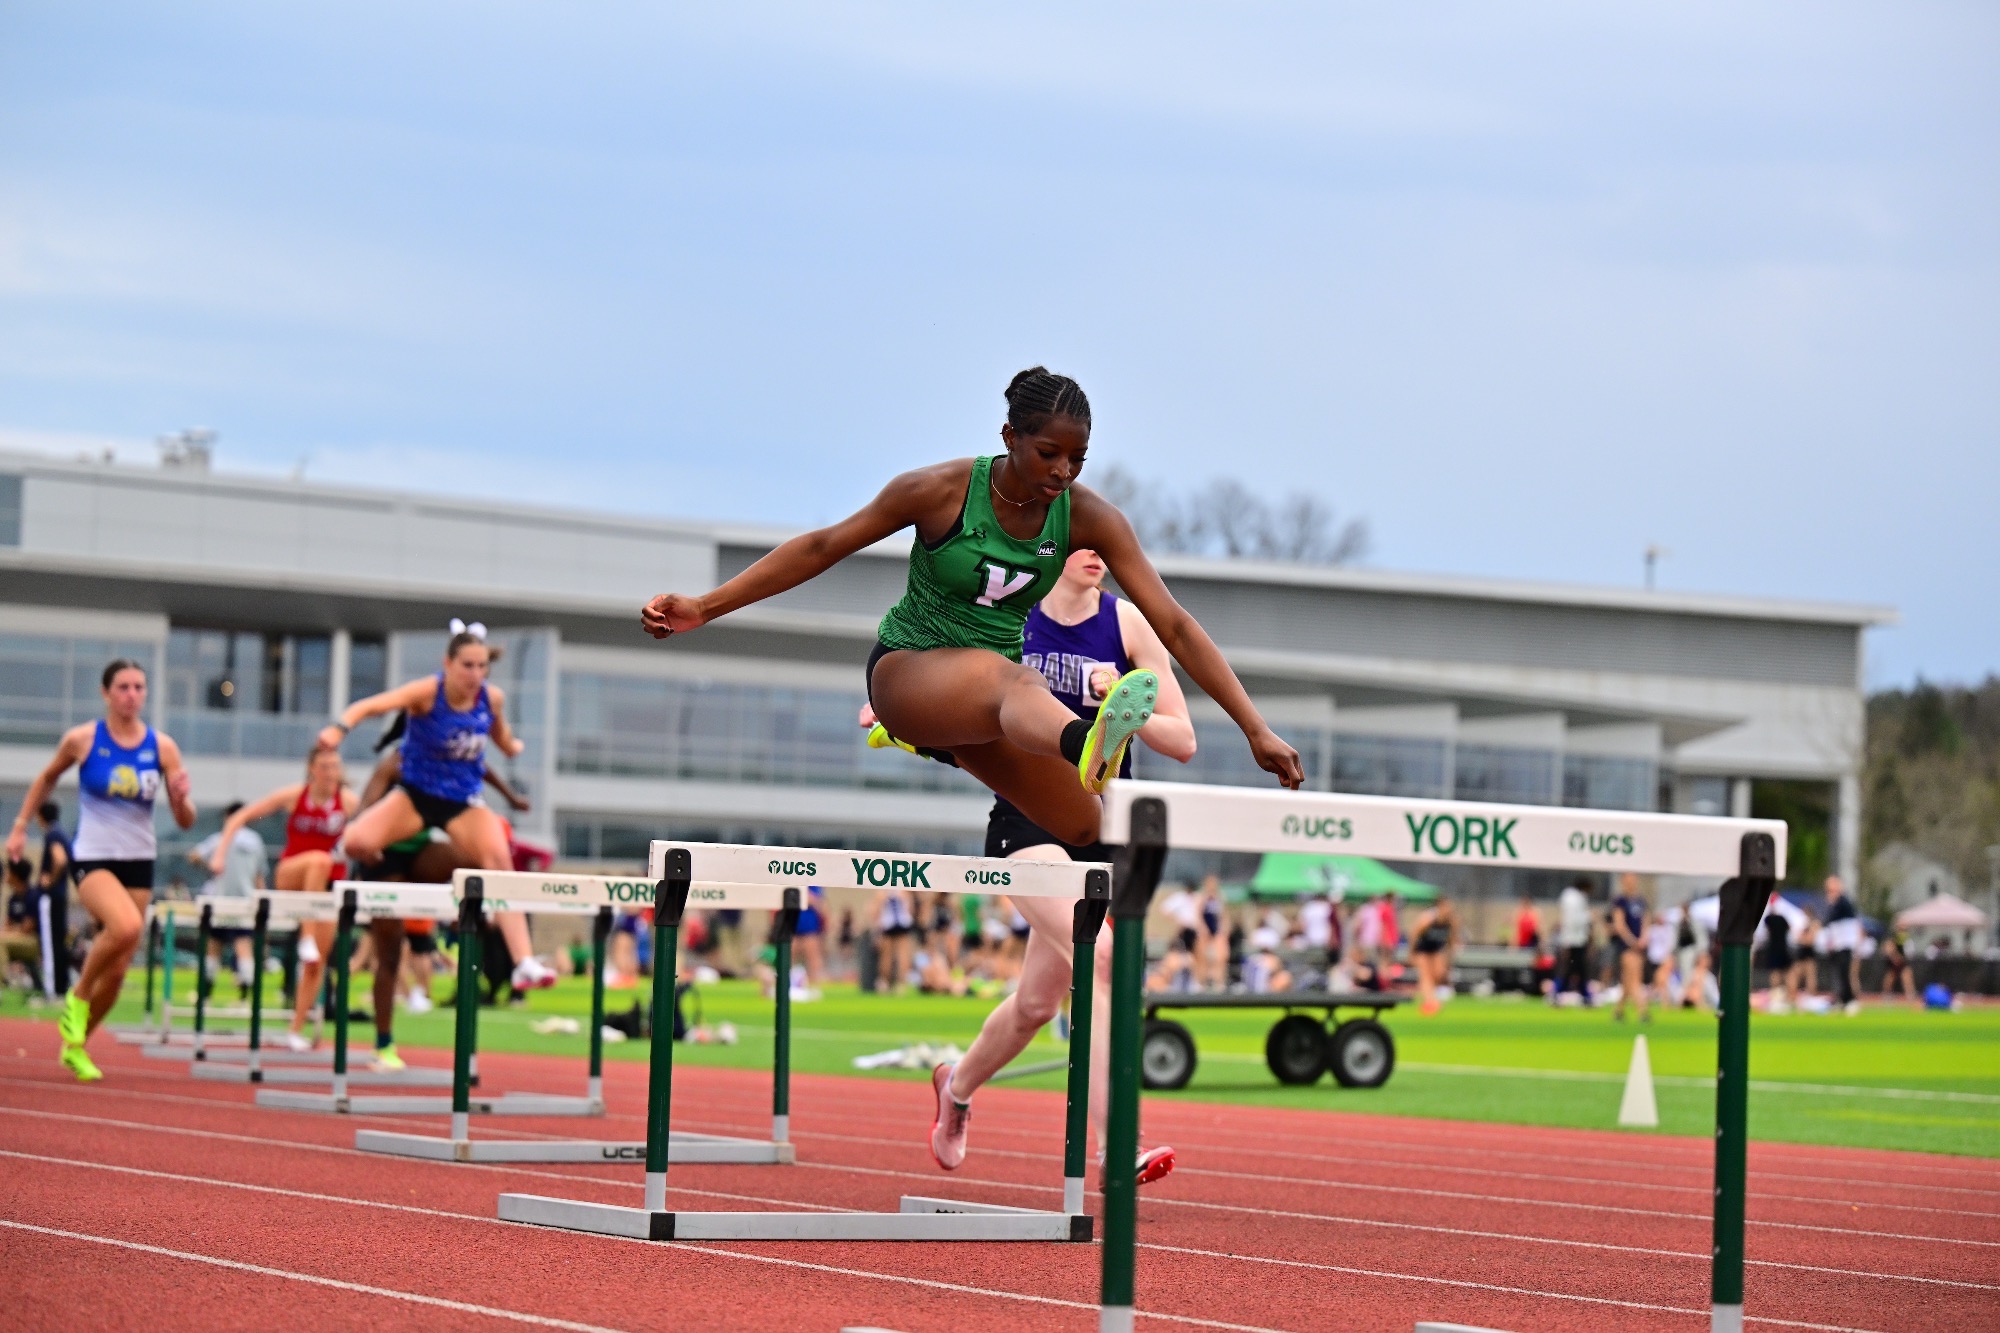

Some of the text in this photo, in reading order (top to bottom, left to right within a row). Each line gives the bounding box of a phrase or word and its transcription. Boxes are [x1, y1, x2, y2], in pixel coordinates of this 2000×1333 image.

[1038, 547, 1056, 555] MAC
[973, 557, 1039, 609] Y
[1303, 813, 1634, 858] UCS YORK UCS
[783, 858, 1012, 888] UCS YORK UCS
[553, 884, 578, 895] UCS
[702, 890, 726, 900] UCS
